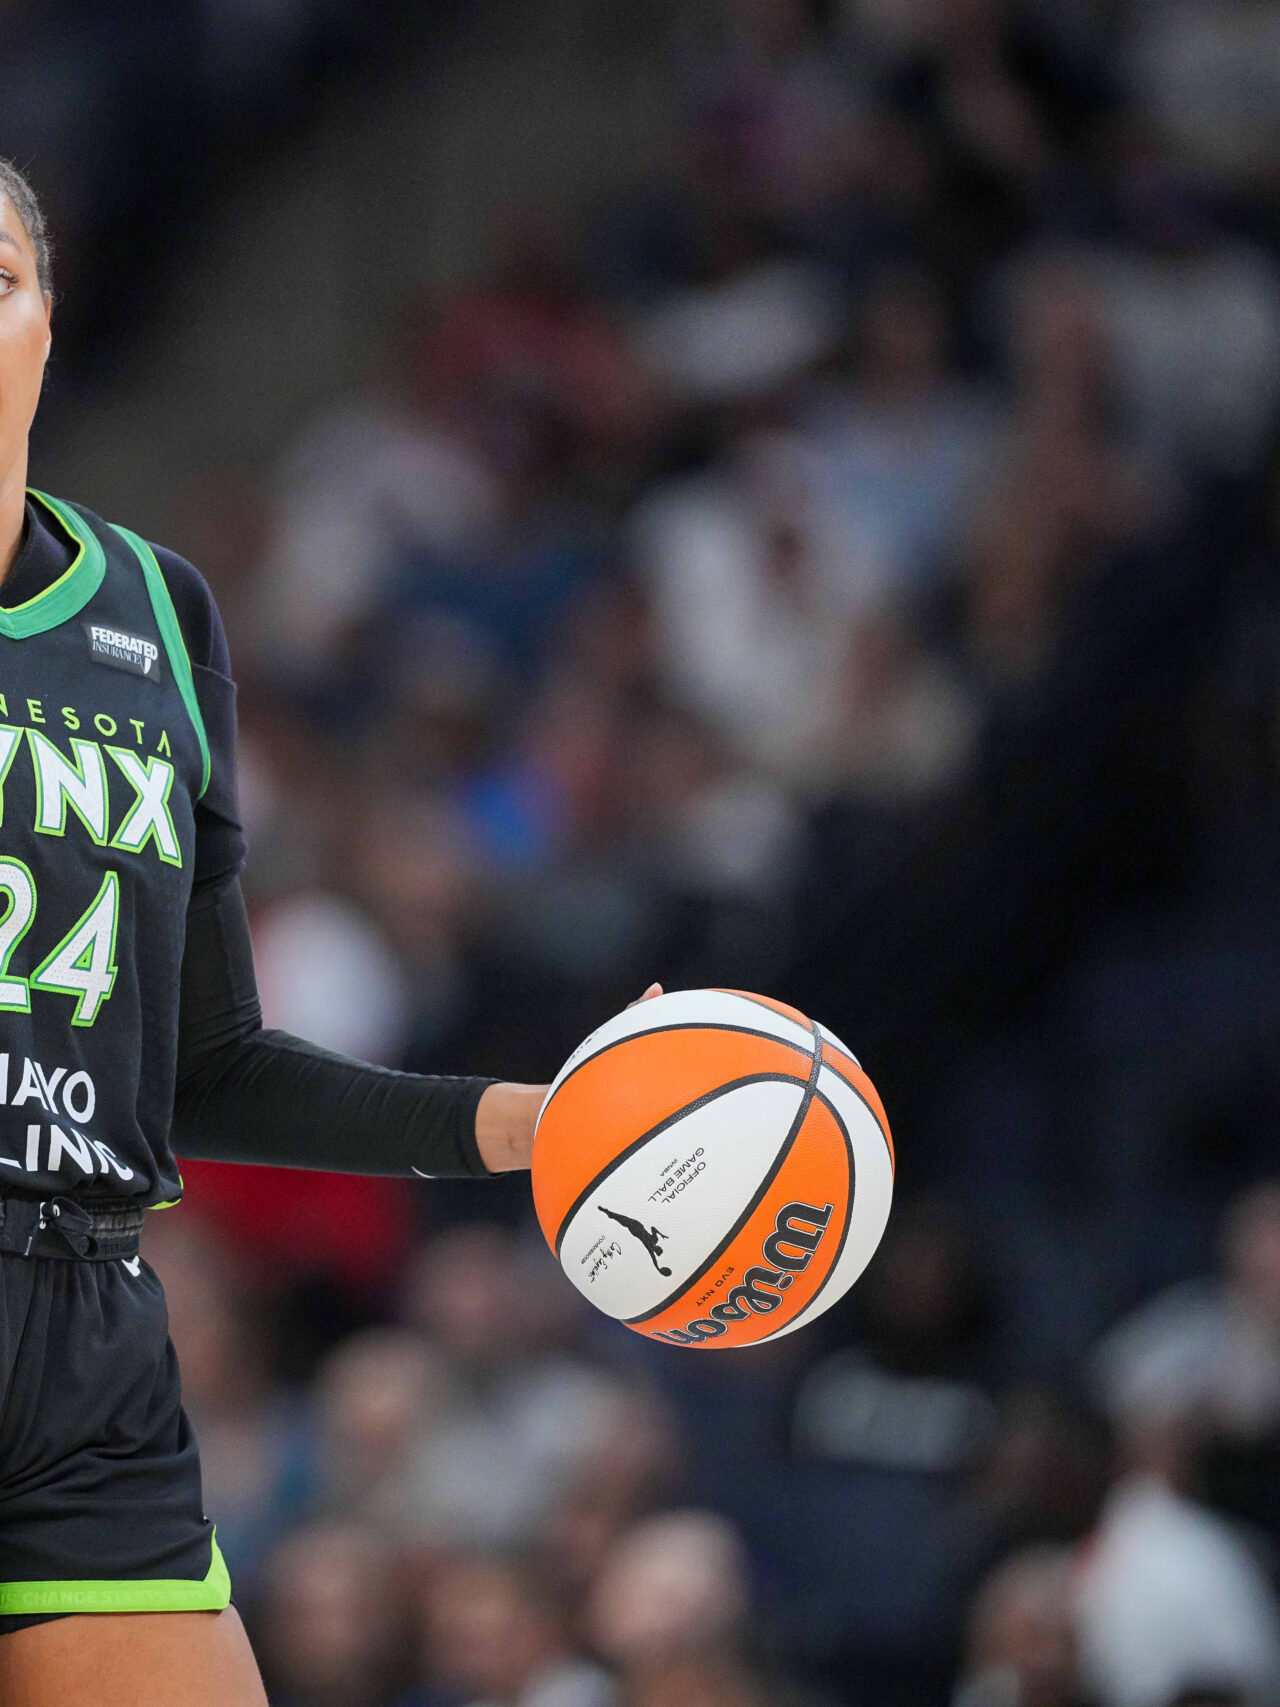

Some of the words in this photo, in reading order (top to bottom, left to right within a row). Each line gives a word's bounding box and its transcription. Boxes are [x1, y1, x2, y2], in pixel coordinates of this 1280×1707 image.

[91, 626, 158, 660] FEDERATED
[92, 640, 141, 665] INSURANCE
[659, 1158, 679, 1177] WNBA
[673, 1147, 705, 1179] GAME
[647, 1177, 675, 1201] BALL
[661, 1161, 706, 1203] OFFICIAL
[714, 1266, 734, 1288] EVO
[696, 1289, 715, 1307] NXT
